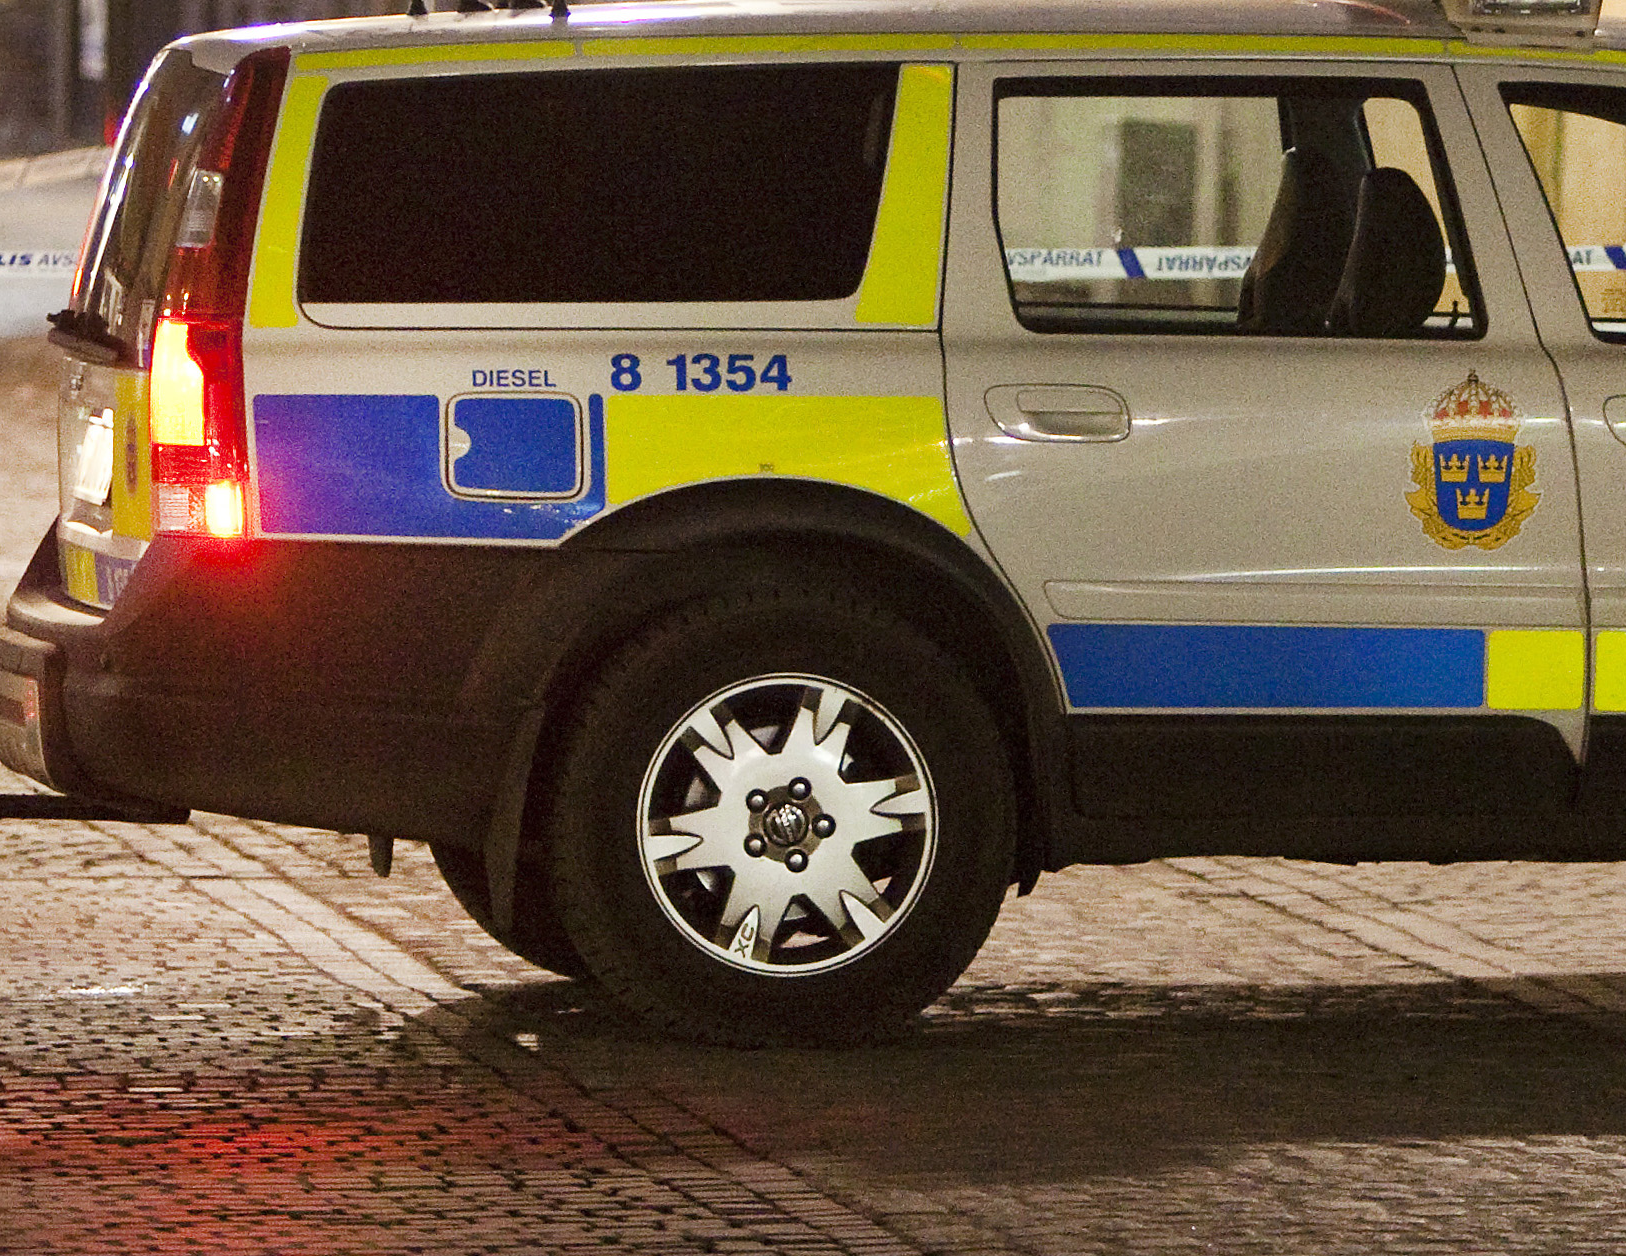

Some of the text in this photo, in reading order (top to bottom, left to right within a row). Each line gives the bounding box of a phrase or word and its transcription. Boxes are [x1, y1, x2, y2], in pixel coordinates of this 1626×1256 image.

[471, 369, 558, 388] DIESEL
[609, 353, 794, 392] 8 1354
